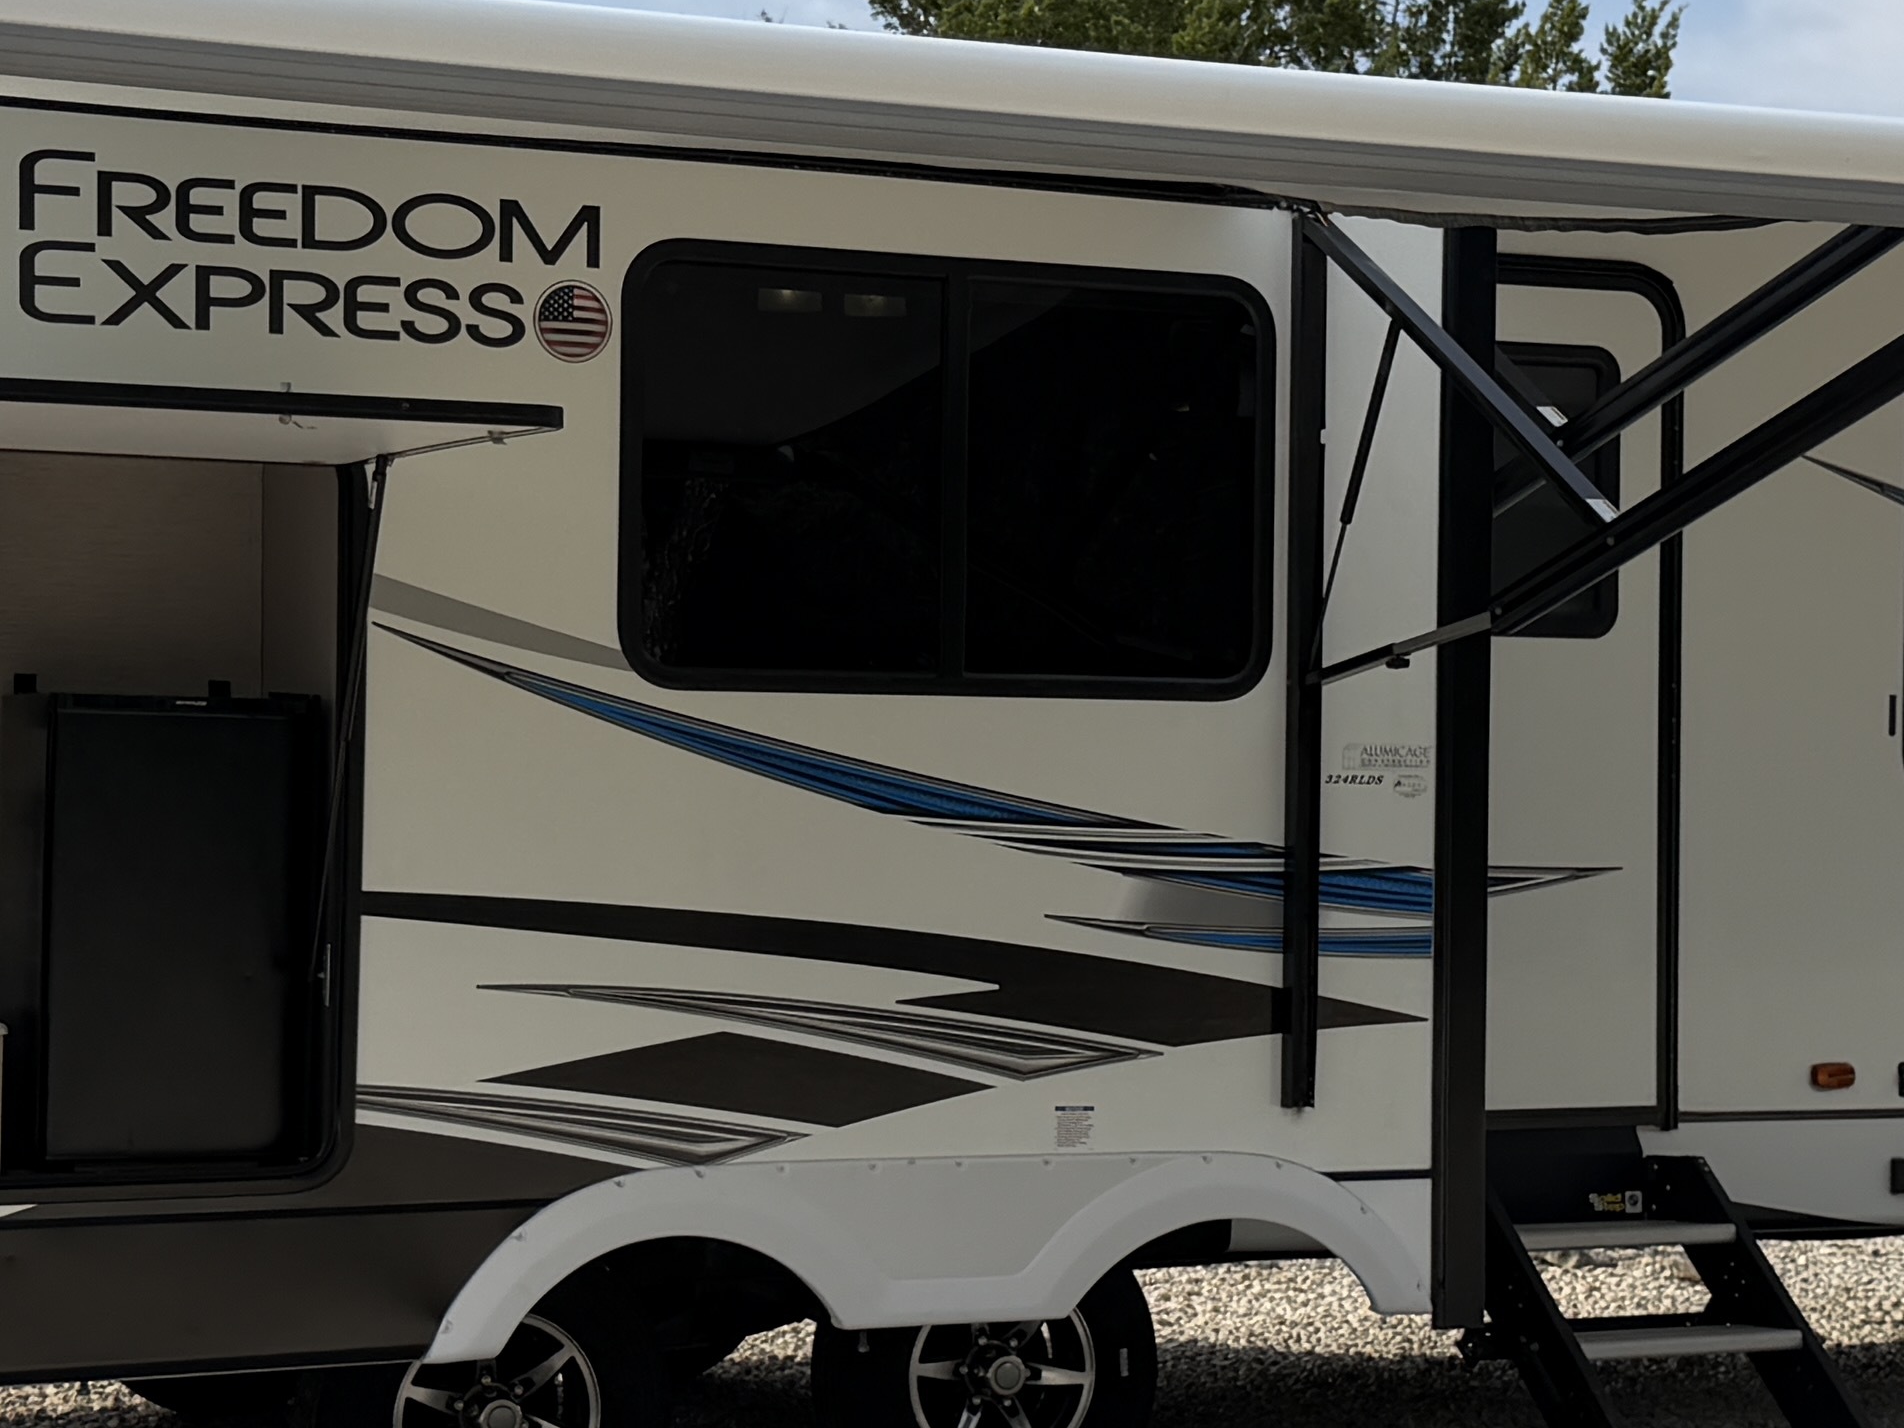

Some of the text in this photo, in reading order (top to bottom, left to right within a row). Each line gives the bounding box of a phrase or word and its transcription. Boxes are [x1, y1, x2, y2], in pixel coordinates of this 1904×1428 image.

[18, 148, 601, 269] FREEDOM
[18, 239, 526, 349] EXPRESS
[1324, 773, 1384, 785] 324RLDS
[1360, 745, 1433, 758] ALUMICAGE
